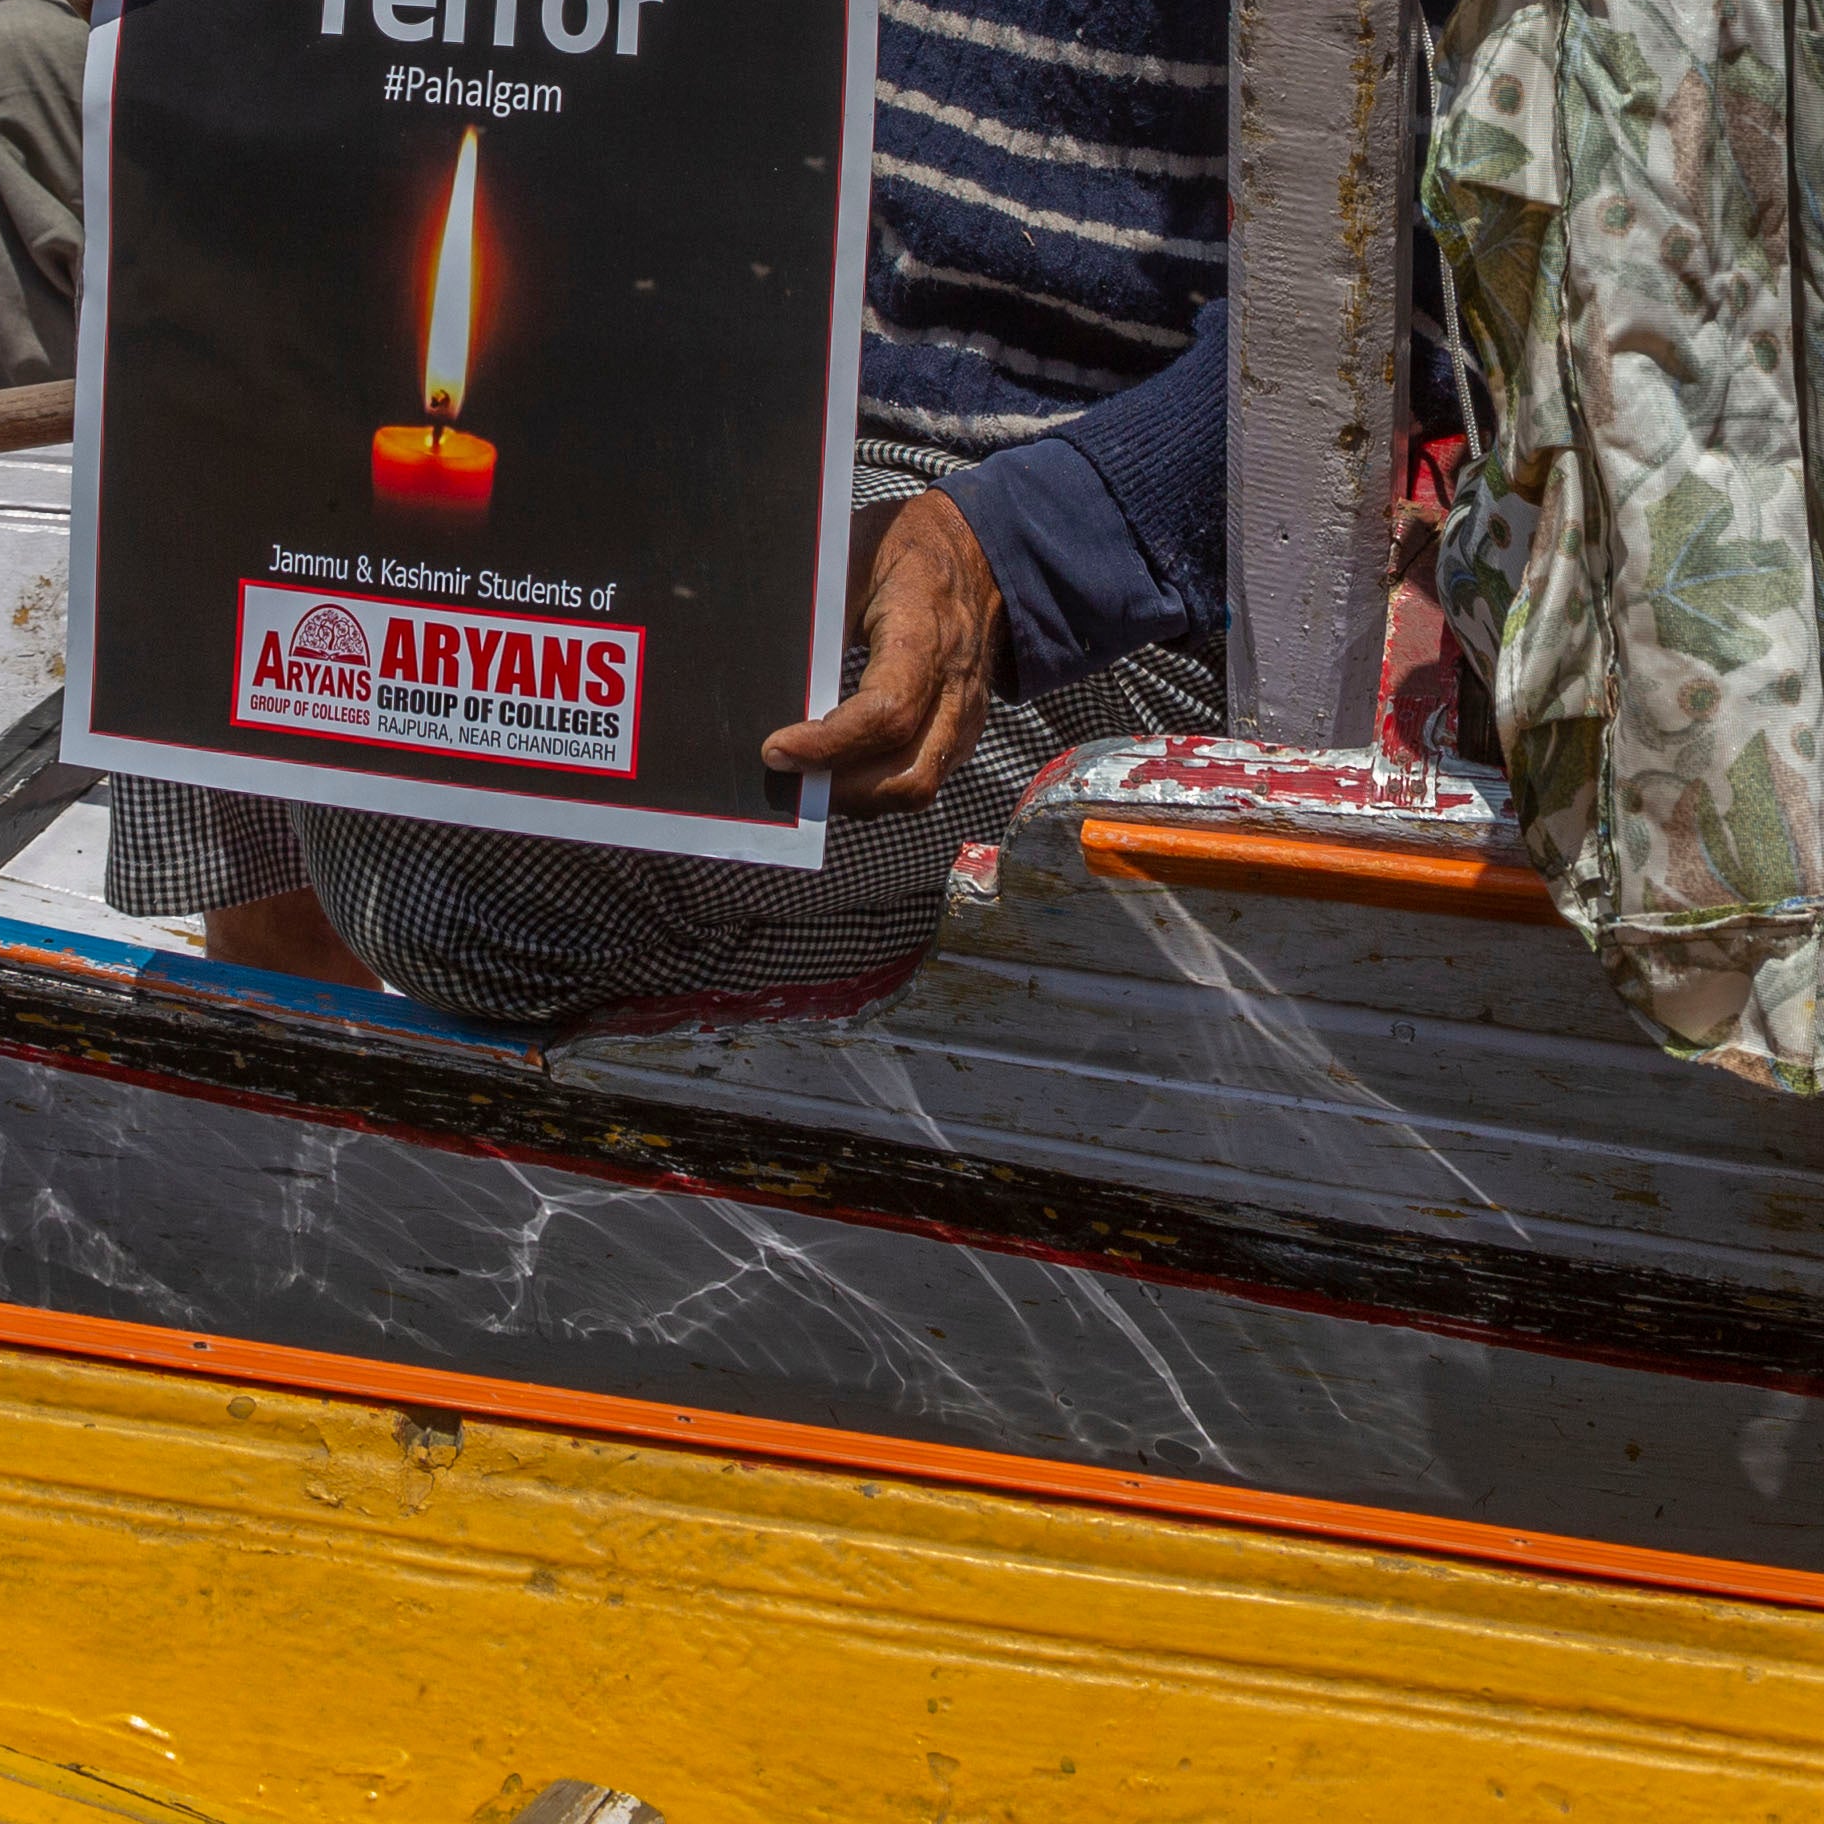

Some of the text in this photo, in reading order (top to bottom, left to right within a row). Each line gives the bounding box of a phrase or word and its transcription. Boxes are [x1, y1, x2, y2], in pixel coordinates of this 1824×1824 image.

[383, 64, 563, 118] #Pahalgam
[269, 544, 616, 612] Jammu & Kashmir Students of
[252, 630, 372, 703] ARYANS
[378, 617, 626, 708] ARYANS
[250, 694, 371, 727] GROUP OF COLLEGES
[377, 683, 620, 739] GROUP OF COLLEGES
[377, 715, 616, 762] RAJPURA, NEAR CHANDIGARH
